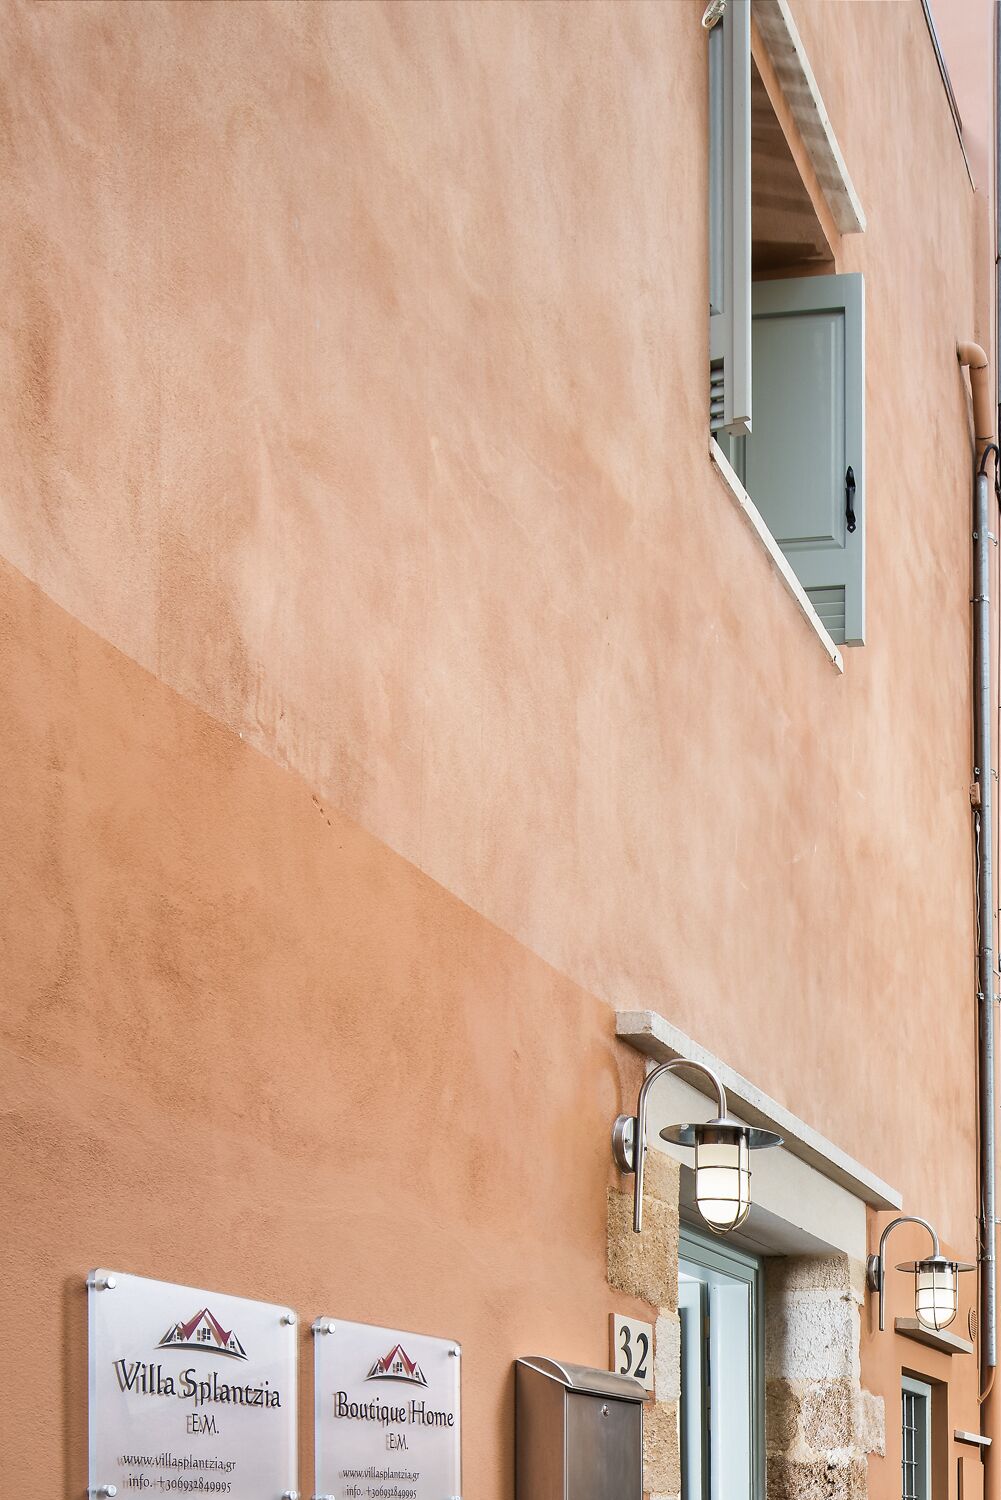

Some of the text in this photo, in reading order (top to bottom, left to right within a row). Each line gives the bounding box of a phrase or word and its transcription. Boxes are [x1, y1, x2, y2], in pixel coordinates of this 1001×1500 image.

[620, 1325, 649, 1379] 32
[118, 1359, 281, 1408] Villa Splantzia
[336, 1391, 454, 1427] Boutique Home
[122, 1453, 236, 1472] www.villasplantzia.gr
[342, 1467, 420, 1482] www.villasplantzia.gr
[128, 1473, 232, 1493] info. +306932849995
